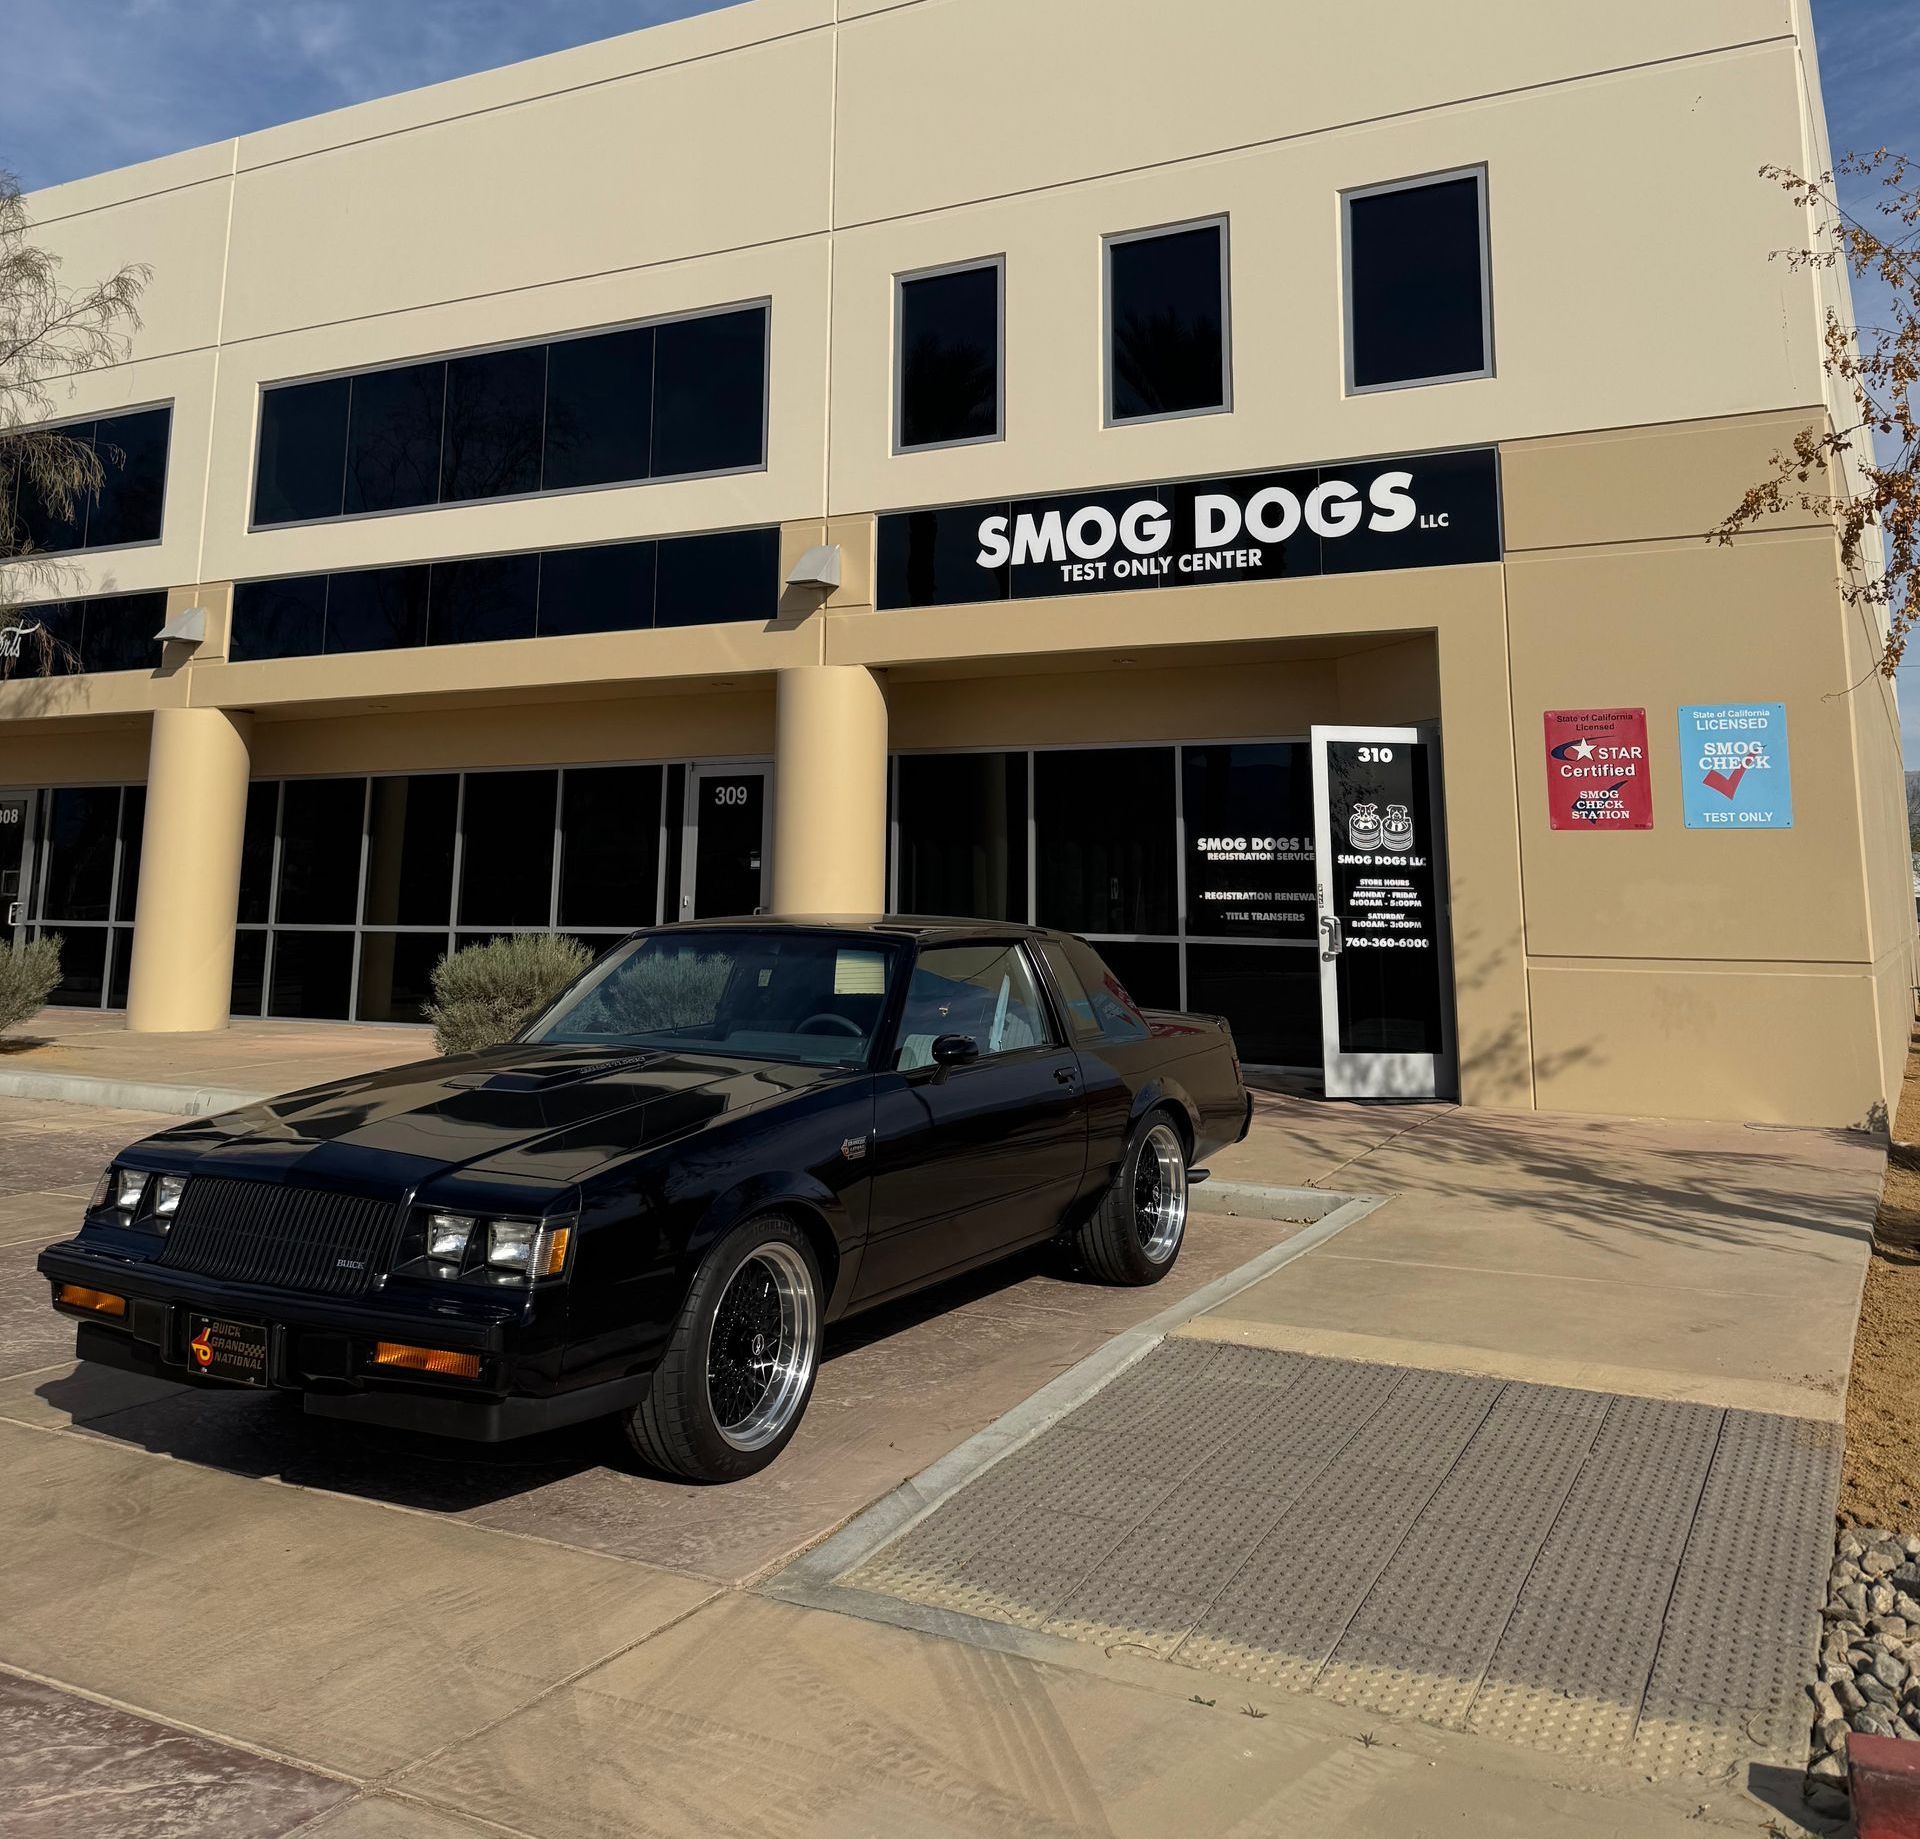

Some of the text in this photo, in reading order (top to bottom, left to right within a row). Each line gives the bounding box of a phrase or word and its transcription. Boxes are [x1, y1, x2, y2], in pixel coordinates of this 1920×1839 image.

[976, 472, 1448, 568] SMOG DOGS LLC
[1061, 549, 1262, 582] TEST ONLY CENTER
[1557, 715, 1578, 723] State
[1591, 713, 1633, 721] California
[1693, 711, 1714, 719] State
[1576, 723, 1614, 731] Licensed
[1696, 719, 1768, 730] LICENSED
[1598, 747, 1642, 759] STAR
[1704, 742, 1764, 755] SMOG
[1358, 748, 1392, 763] 310
[1699, 756, 1771, 770] CHECK
[1561, 764, 1636, 777] Certified
[715, 786, 748, 805] 309
[1580, 790, 1619, 799] SMOG
[1576, 800, 1624, 809] CHECK
[1572, 811, 1630, 819] STATION
[1704, 812, 1773, 822] TEST ONLY
[1197, 838, 1247, 851] SMOG
[1252, 838, 1299, 850] DOGS
[1338, 855, 1426, 866] SMOG DOGS LLC
[1205, 892, 1272, 900] REGISTRATION
[1251, 913, 1305, 921] TRANSFERS
[1346, 938, 1429, 947] 760-360-6000
[336, 1259, 365, 1269] BUICK
[212, 1322, 241, 1337] BUICK
[211, 1337, 245, 1352] GRAND
[215, 1352, 262, 1369] NATIONAL
